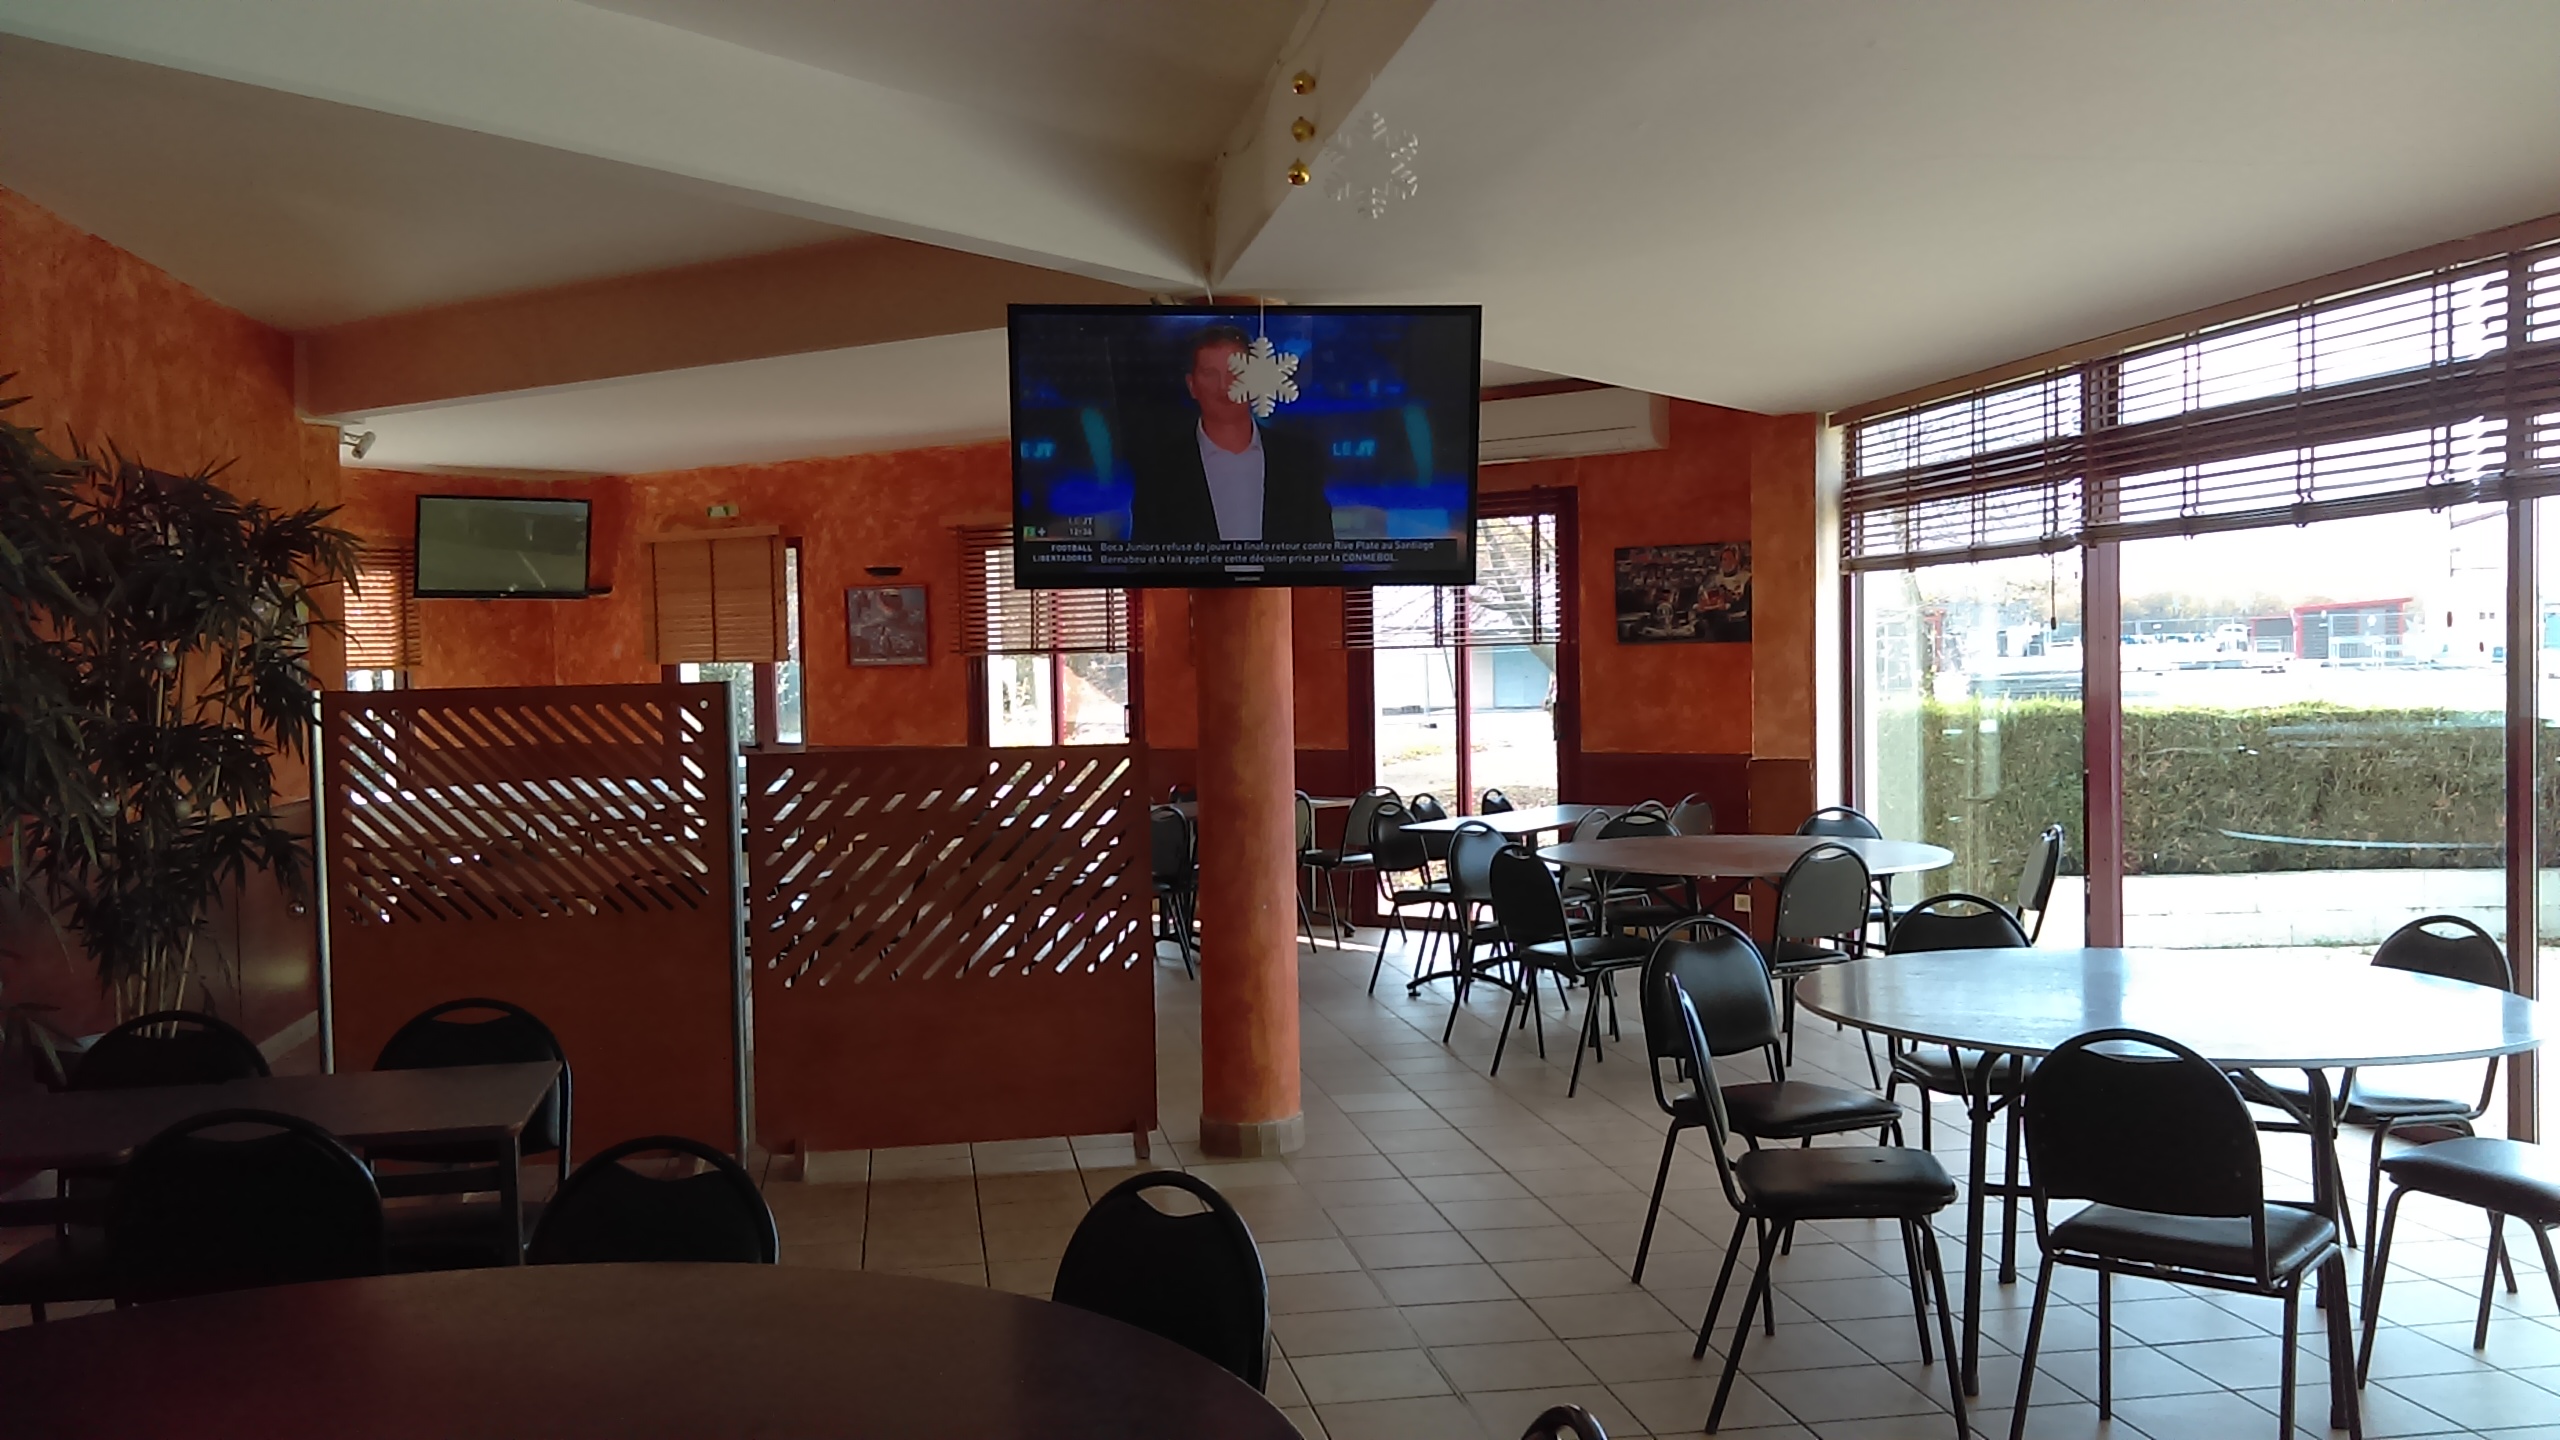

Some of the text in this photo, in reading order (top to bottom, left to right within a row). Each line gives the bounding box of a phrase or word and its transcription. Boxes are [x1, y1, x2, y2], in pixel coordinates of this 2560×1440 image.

[1333, 441, 1351, 456] LE
[1051, 544, 1093, 552] FOOTBALL
[1100, 542, 1124, 552] Boca
[1126, 542, 1160, 552] Juniors
[1162, 542, 1192, 552] refuse
[1194, 542, 1206, 552] de
[1206, 542, 1231, 553] jouer
[1233, 541, 1243, 551] la
[1244, 541, 1270, 551] finale
[1271, 542, 1300, 551] retour
[1302, 541, 1333, 551] contre
[1356, 541, 1378, 550] Plate
[1380, 542, 1393, 550] au
[1395, 541, 1435, 552] Santiago
[1032, 554, 1093, 562] LIBERTADORES
[1100, 554, 1146, 563] Bernabeu
[1148, 555, 1157, 563] et
[1166, 554, 1182, 563] fait
[1184, 554, 1209, 565] appel
[1211, 554, 1223, 563] de
[1224, 554, 1248, 563] cette
[1249, 553, 1287, 563] décision
[1288, 554, 1313, 564] prise
[1314, 554, 1329, 564] par
[1331, 553, 1341, 562] la
